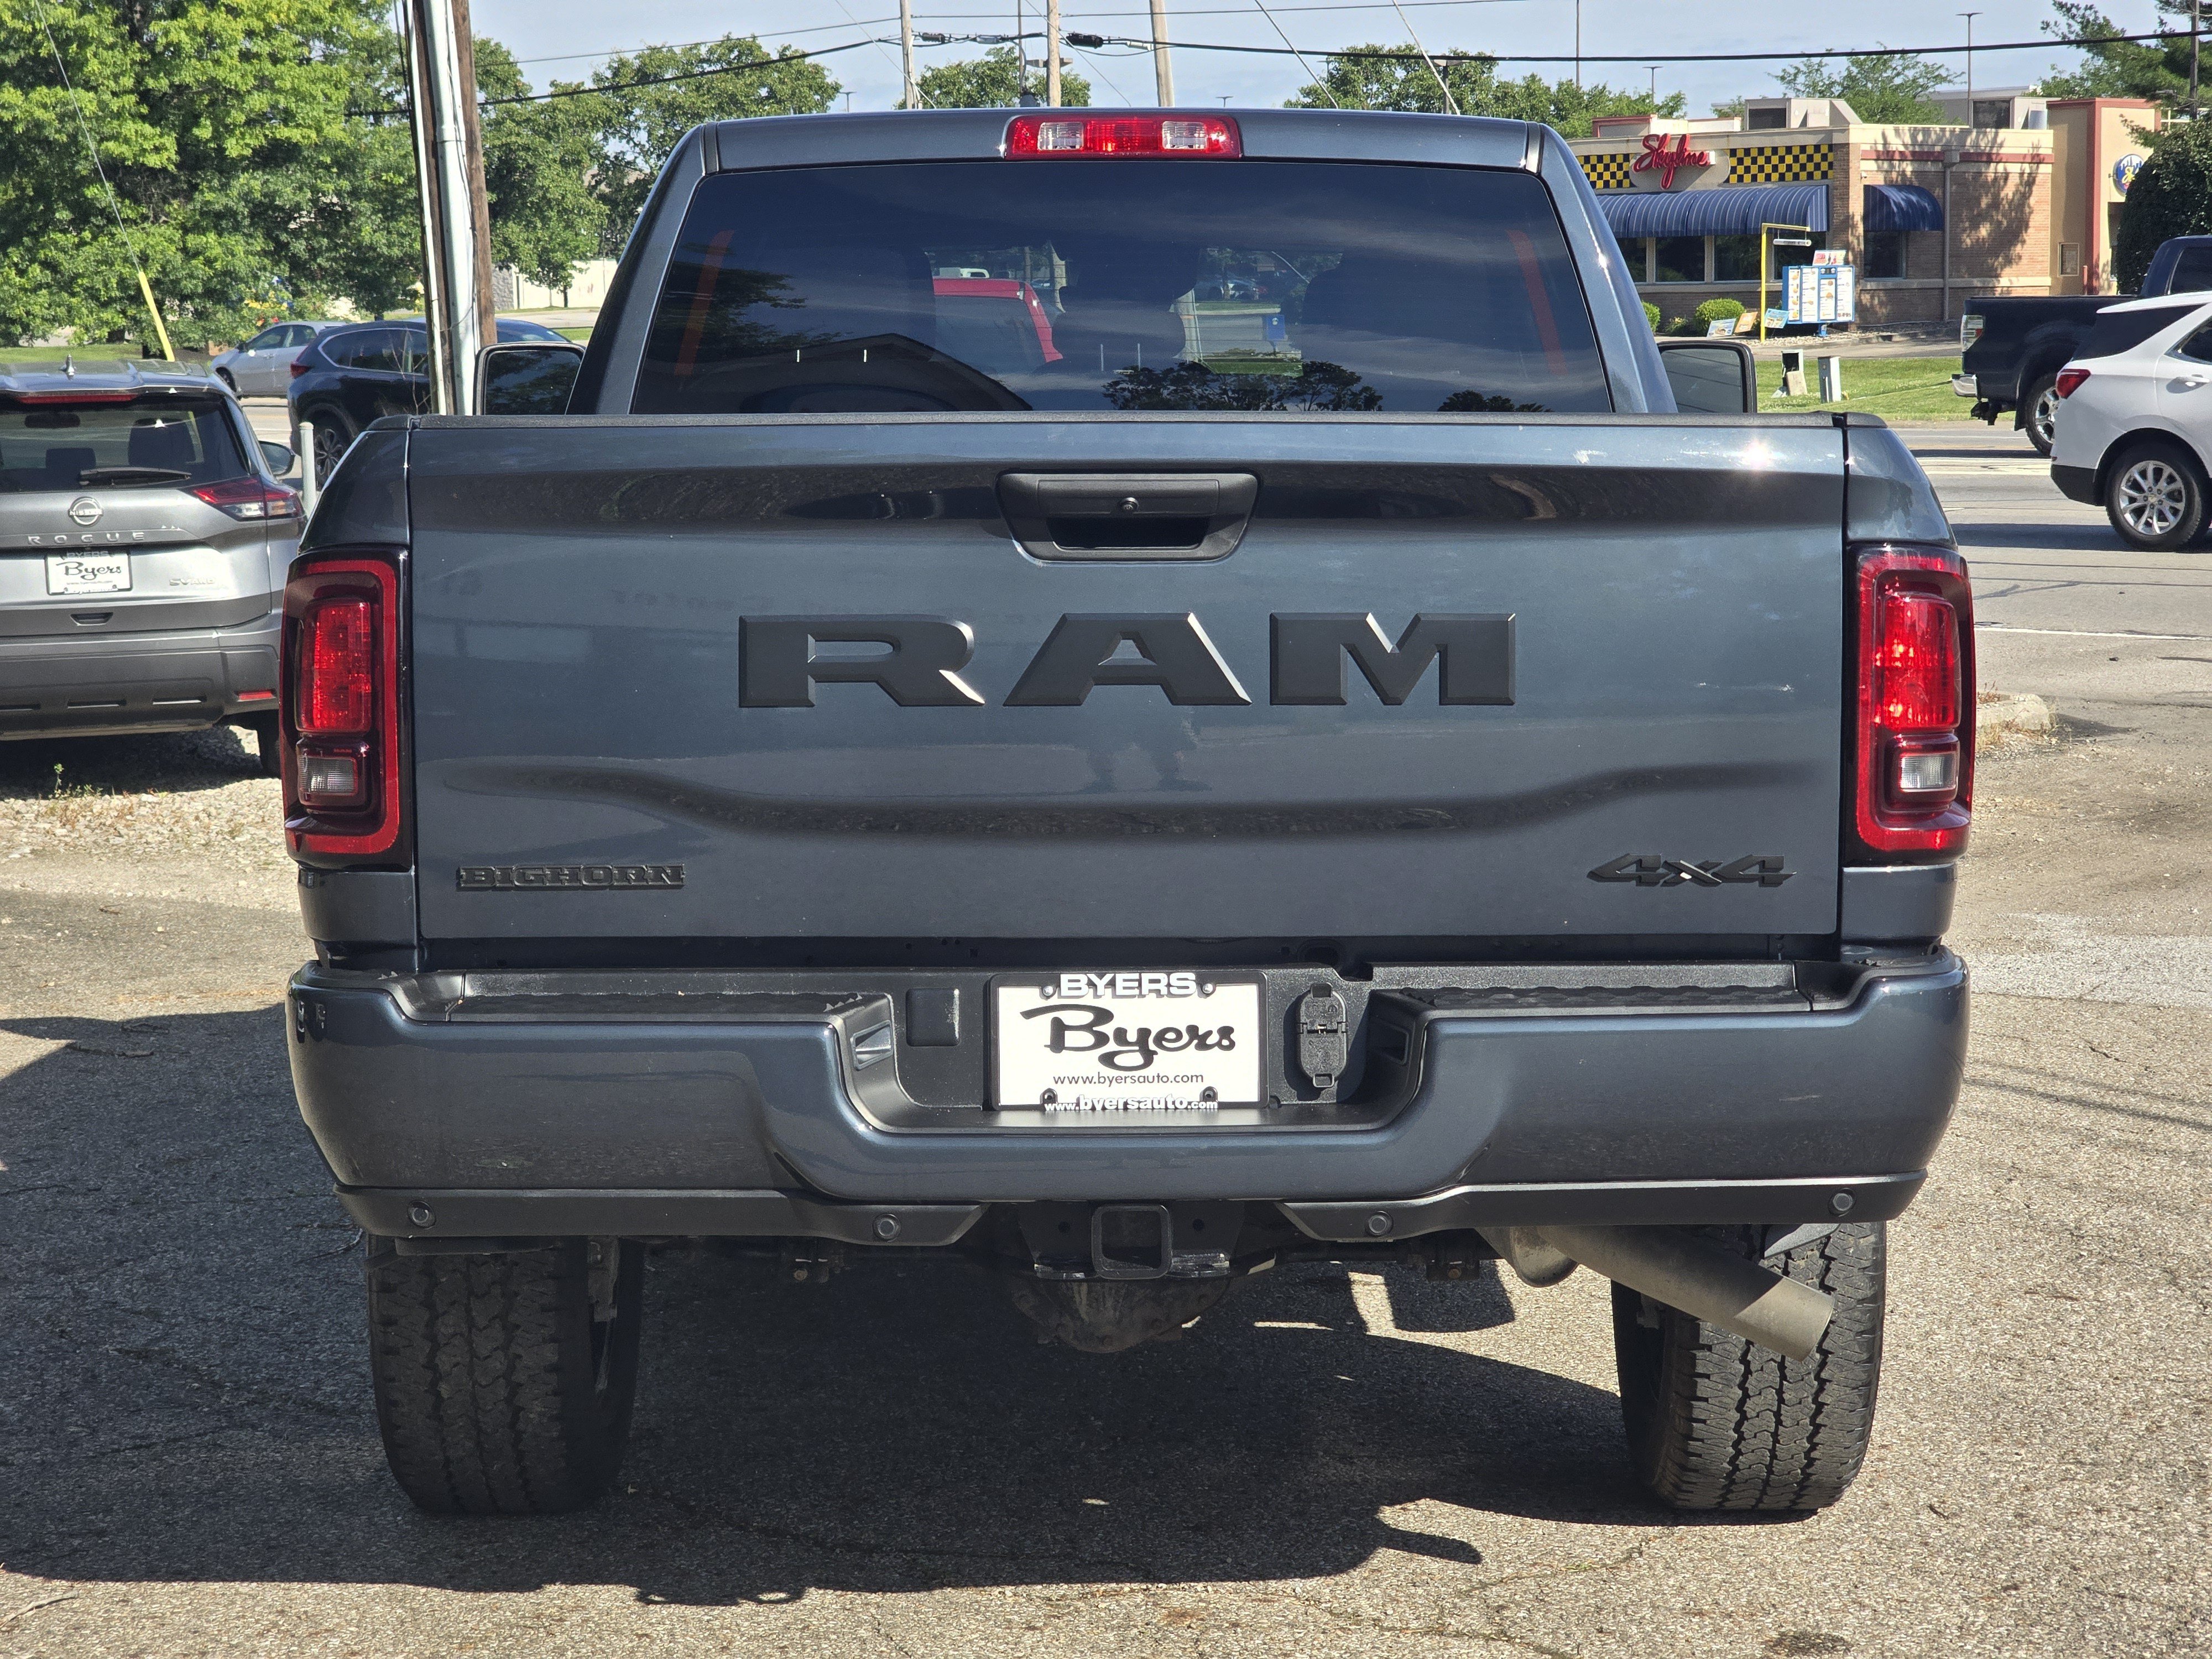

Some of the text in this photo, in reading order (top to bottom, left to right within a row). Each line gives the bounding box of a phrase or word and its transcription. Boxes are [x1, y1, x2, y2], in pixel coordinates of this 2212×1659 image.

[1632, 133, 1710, 189] Skyline
[28, 532, 145, 545] ROGUE
[66, 550, 109, 559] BYERS
[56, 561, 122, 581] Byers
[739, 612, 1516, 707] RAM
[456, 863, 685, 891] BIGHORN
[1060, 972, 1197, 997] BYERS
[1020, 1004, 1236, 1072] Byers
[1053, 1071, 1204, 1087] www.byersauto.com
[1044, 1093, 1218, 1111] www.byersauto.com
